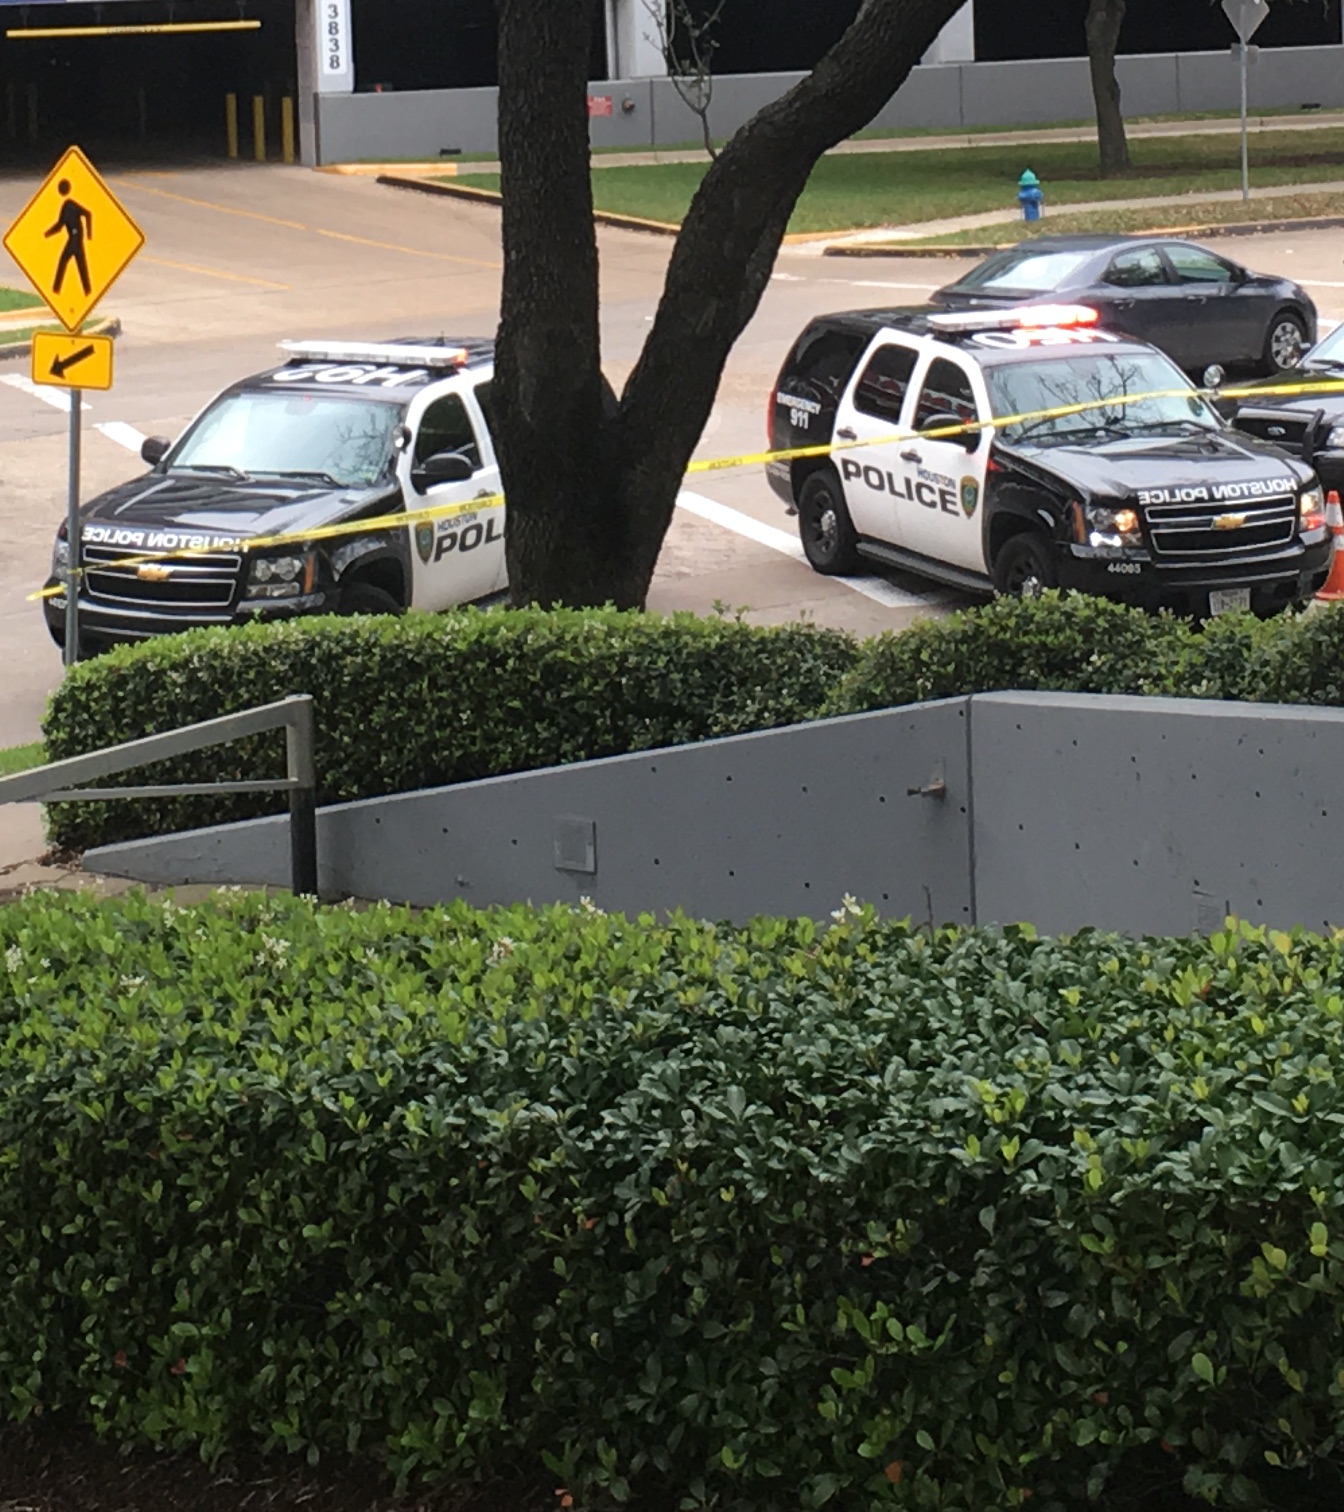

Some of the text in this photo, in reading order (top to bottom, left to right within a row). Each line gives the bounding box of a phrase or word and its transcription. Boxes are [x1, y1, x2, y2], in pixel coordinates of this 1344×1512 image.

[328, 3, 341, 70] 3838
[790, 408, 808, 429] 911
[840, 457, 960, 516] POLICE
[917, 467, 956, 490] HOUSTON
[437, 511, 478, 532] HOUSTON
